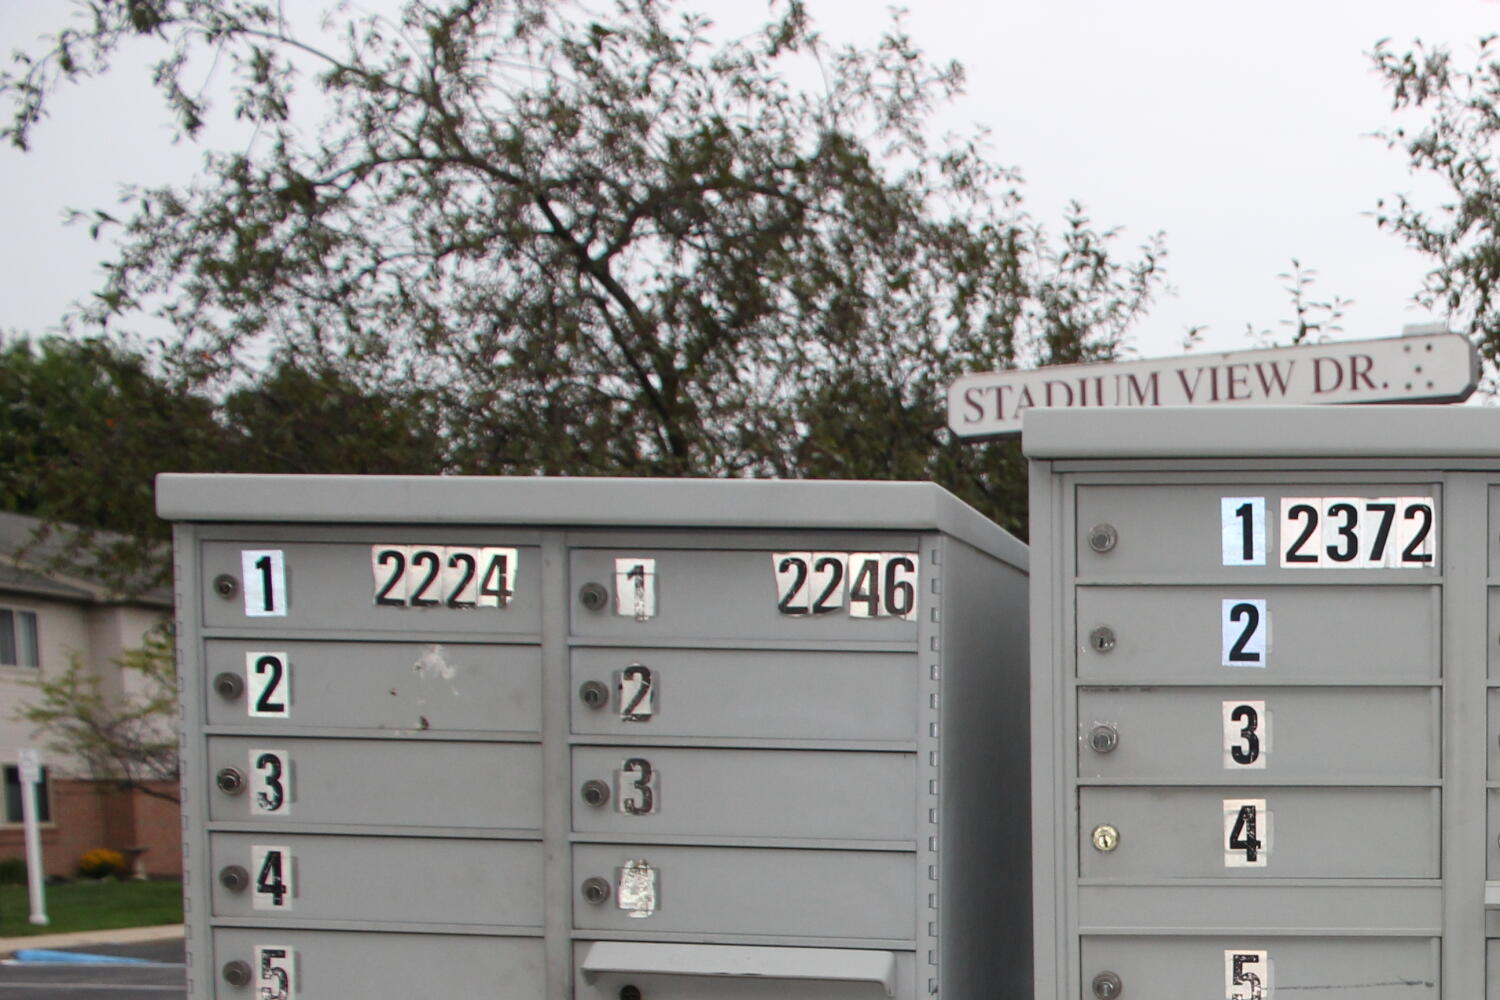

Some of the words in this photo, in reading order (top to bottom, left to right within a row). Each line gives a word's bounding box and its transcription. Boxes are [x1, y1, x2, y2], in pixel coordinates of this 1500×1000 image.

[962, 371, 1161, 423] STADIUM
[1175, 358, 1297, 404] VIEW
[1311, 353, 1390, 395] DR.
[1235, 503, 1254, 561] 1
[1285, 503, 1433, 563] 2372
[255, 555, 274, 612] 1
[374, 550, 513, 611] 2224
[626, 564, 648, 620] 1
[776, 557, 915, 619] 2246
[1228, 602, 1260, 662] 2
[256, 655, 285, 713] 2
[620, 665, 653, 722] 2
[1231, 705, 1260, 765] 3
[256, 753, 284, 812] 3
[623, 757, 653, 816] 3
[1229, 805, 1262, 862] 4
[257, 850, 287, 906] 4
